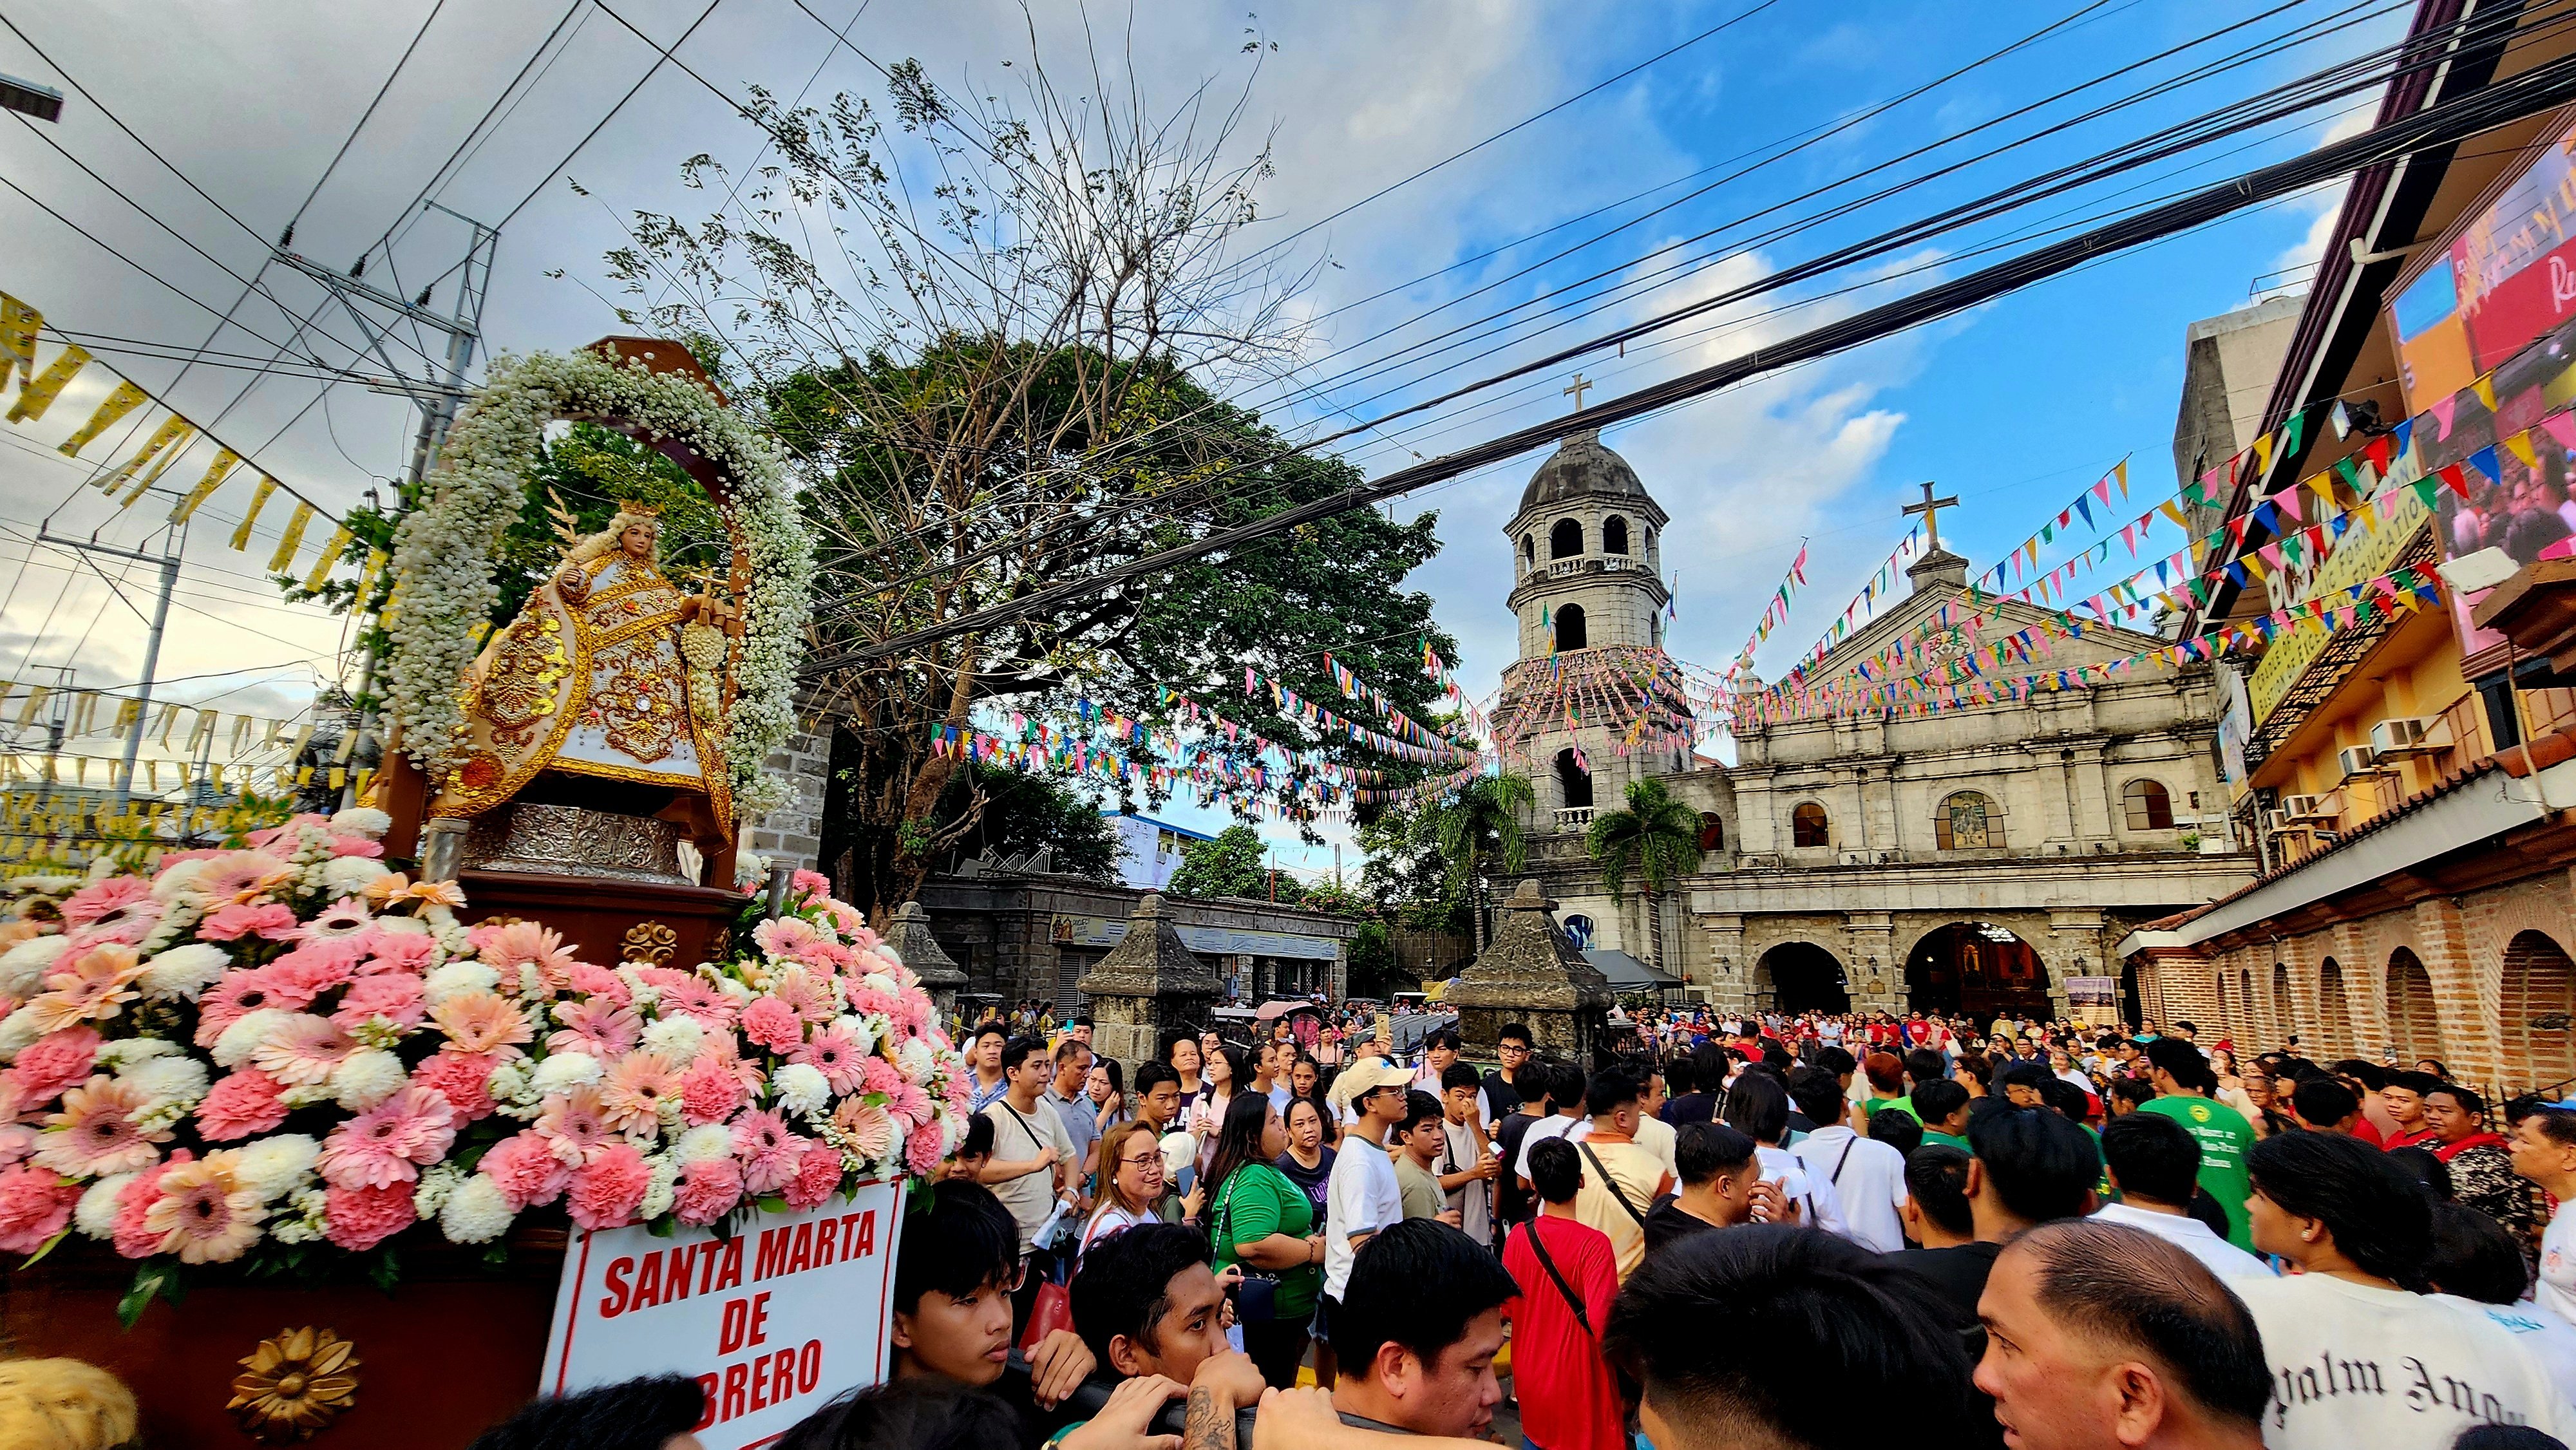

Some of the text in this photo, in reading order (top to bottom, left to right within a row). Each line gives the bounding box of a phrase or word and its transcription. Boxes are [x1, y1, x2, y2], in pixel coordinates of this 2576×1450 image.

[2353, 492, 2426, 584] EDUCATIO
[600, 1209, 876, 1320] SANTA MARTA
[717, 1290, 772, 1357] DE
[689, 1338, 822, 1435] BRERO
